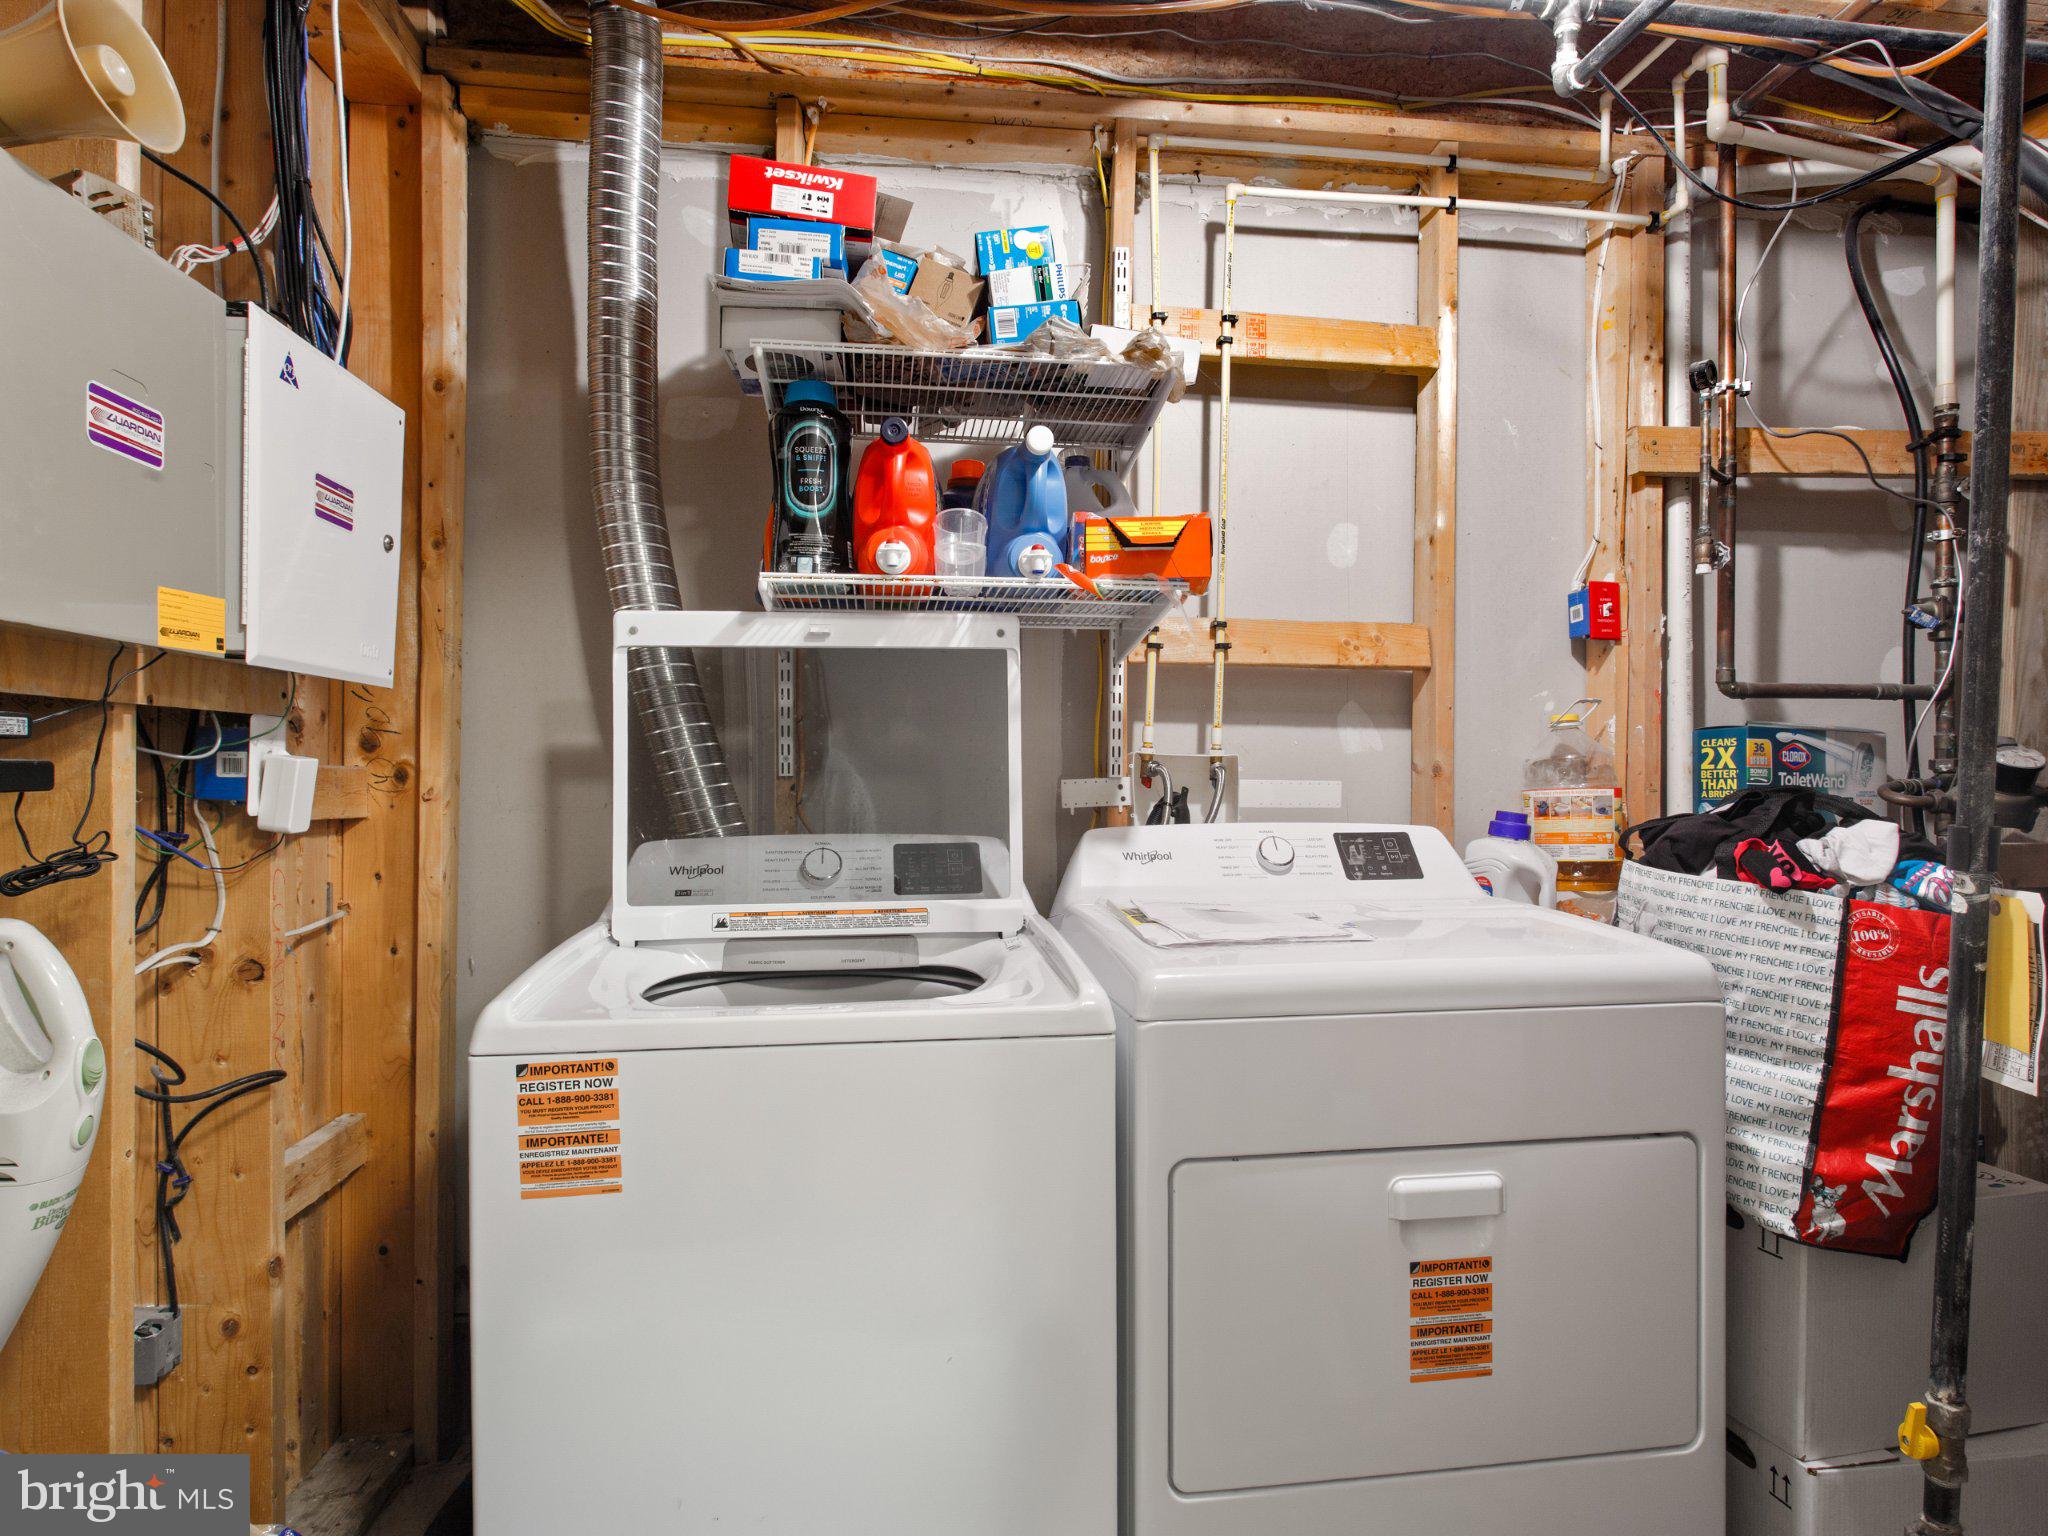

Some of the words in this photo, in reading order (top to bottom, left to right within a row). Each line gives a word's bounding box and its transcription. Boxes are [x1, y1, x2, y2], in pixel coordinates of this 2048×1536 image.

[764, 166, 844, 190] Kwikset
[1056, 264, 1066, 299] PHILIPS
[800, 406, 824, 415] Downy
[107, 414, 161, 442] GUARDIAN
[794, 446, 827, 455] SQUEEZE
[1090, 554, 1119, 564] bounce
[1701, 738, 1737, 747] CLEANS
[1754, 743, 1765, 752] 36
[1701, 748, 1737, 769] 2X
[1782, 752, 1807, 762] CLOROX
[1701, 778, 1737, 789] THAN
[1778, 772, 1845, 788] ToiletWand
[1122, 849, 1173, 865] Whirlpool
[669, 864, 724, 879] Whirlpool
[1667, 875, 1677, 884] MY
[1679, 877, 1715, 892] FRENCHIE
[1721, 884, 1742, 894] LOVE
[1745, 886, 1758, 897] MY
[1760, 889, 1804, 904] FRENCHIE
[1812, 899, 1836, 910] LOVE
[1701, 896, 1712, 907] MY
[1714, 899, 1755, 912] FRENCHIE
[1762, 907, 1785, 918] LOVE
[1789, 911, 1803, 920] MY
[1805, 913, 1840, 927] FRENCH
[1674, 909, 1708, 922] FRENCHIE
[1716, 916, 1737, 927] LOVE
[1740, 919, 1752, 929] MY
[1754, 922, 1799, 937] FRENCHIE
[1807, 930, 1830, 943] LOVE
[1852, 929, 1889, 942] 100%
[1696, 928, 1707, 937] MY
[1709, 930, 1750, 944] FRENCHIE
[1757, 938, 1780, 950] LOVE
[1784, 942, 1797, 952] MY
[1800, 945, 1836, 959] FRENCH
[1856, 945, 1898, 959] REUSABLE
[1712, 948, 1732, 958] LOVE
[1735, 951, 1748, 960] MY
[1750, 954, 1796, 970] FRENCHIE
[1802, 964, 1826, 975] LOVE
[1752, 971, 1775, 983] LOVE
[1780, 976, 1793, 986] MY
[1745, 986, 1790, 1004] FRENCHIE
[1797, 997, 1820, 1010] LOVE
[1748, 1004, 1771, 1016] LOVE
[1774, 1009, 1788, 1020] MY
[1726, 1015, 1738, 1024] MY
[1741, 1019, 1783, 1036] FRENCHIE
[1792, 1030, 1816, 1042] LOVE
[1745, 1034, 1766, 1046] LOVE
[1770, 1041, 1783, 1050] MY
[1738, 1048, 1780, 1066] FRENCHIE
[1790, 1060, 1816, 1074] LOVE
[530, 1062, 604, 1076] IMPORTANT!
[1740, 1064, 1761, 1076] LOVE
[1764, 1070, 1777, 1080] MY
[519, 1080, 581, 1093] REGISTER
[584, 1078, 613, 1088] NOW
[1730, 1076, 1772, 1094] FRENCHIE
[1781, 1091, 1806, 1105] LOVE
[1861, 965, 1950, 1219] Marshalls
[519, 1097, 544, 1106] CALL
[547, 1093, 614, 1105] 1-888-900-3381
[1731, 1094, 1753, 1108] LOVE
[1757, 1100, 1770, 1112] MY
[1775, 1122, 1798, 1136] LOVE
[526, 1133, 608, 1147] IMPORTANTE!
[1751, 1132, 1765, 1142] MY
[520, 1150, 570, 1159] ENREGISTREZ
[572, 1146, 618, 1155] MAINTENANT
[1769, 1152, 1792, 1164] LOVE
[1747, 1164, 1761, 1174] MY
[1762, 1167, 1802, 1184] FRENCHI
[1765, 1185, 1789, 1199] LOVE
[1421, 1260, 1481, 1273] IMPORTANT!
[1413, 1276, 1462, 1288] REGISTER
[1465, 1274, 1489, 1283] NOW
[1417, 1323, 1484, 1337] IMPORTANTE!
[1453, 1335, 1491, 1343] MAINTENANT
